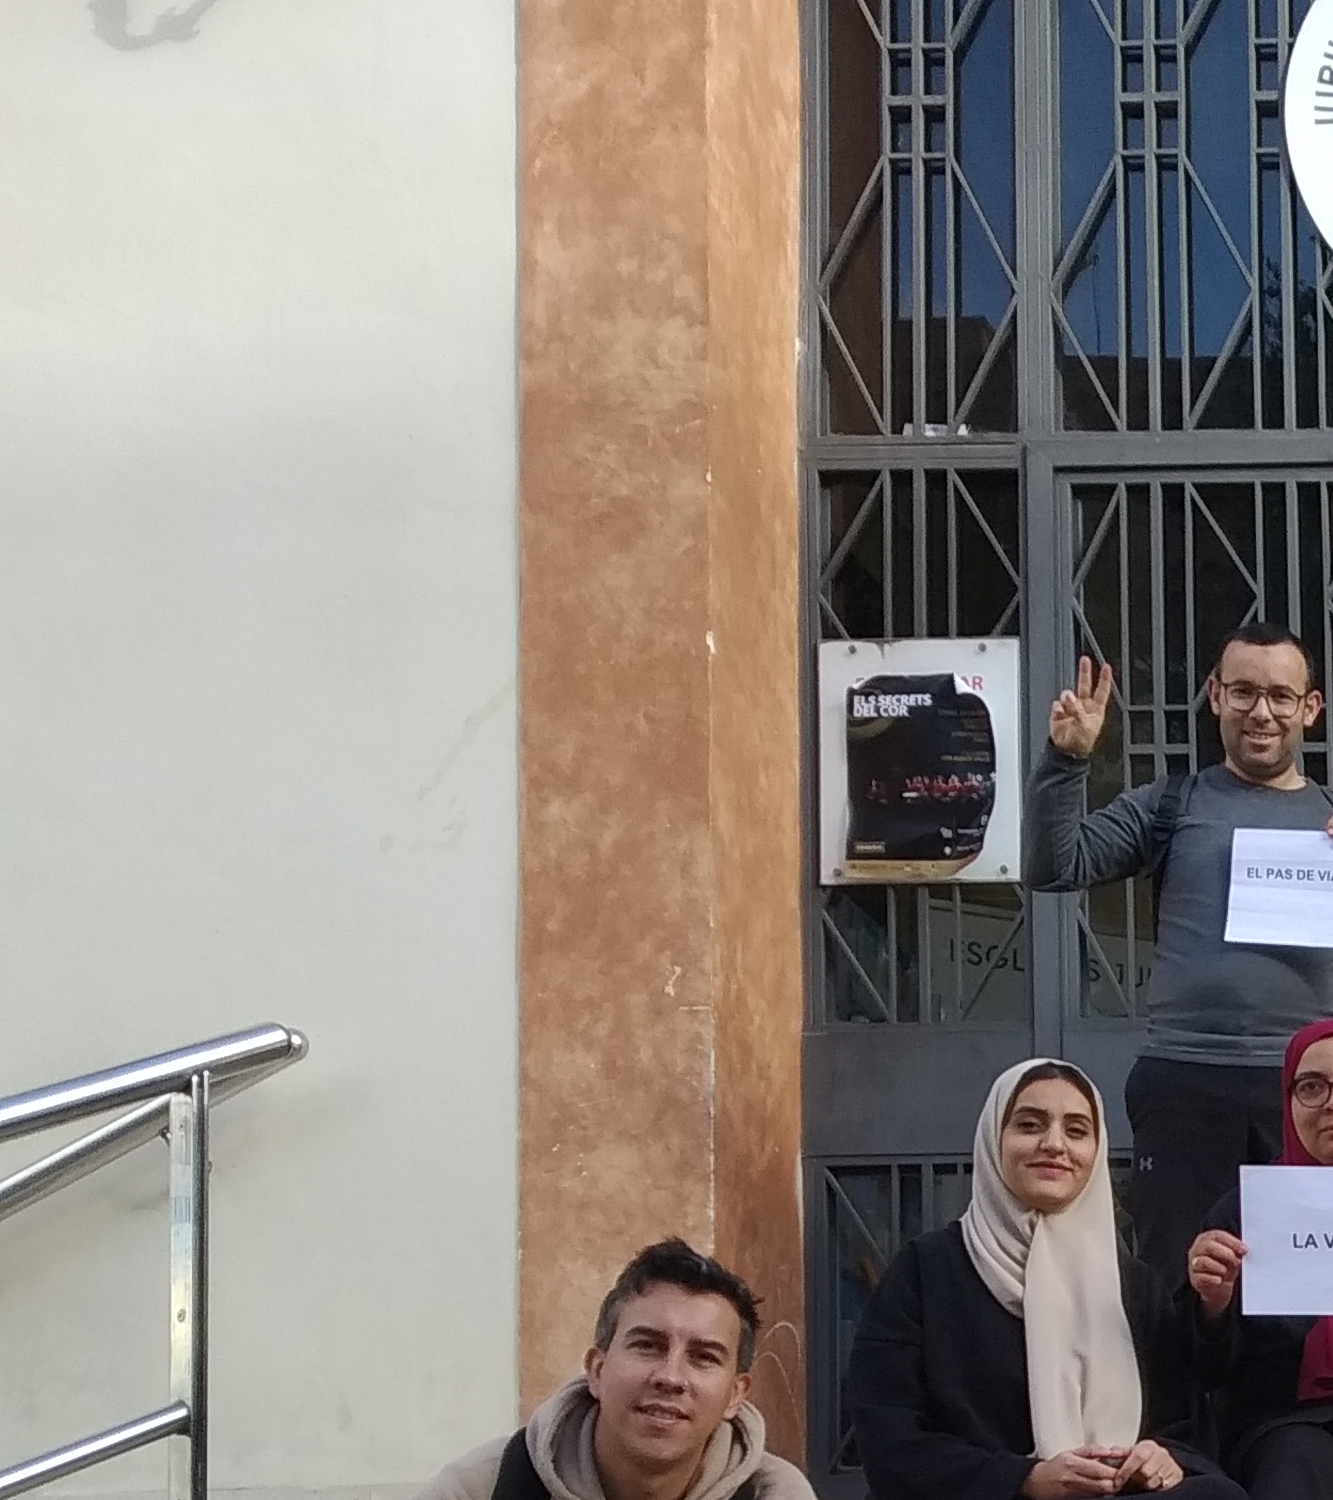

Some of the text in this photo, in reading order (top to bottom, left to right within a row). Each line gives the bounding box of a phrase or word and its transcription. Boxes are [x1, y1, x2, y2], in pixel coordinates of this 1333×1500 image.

[853, 693, 933, 706] ELS SECRETS
[853, 705, 910, 717] DEL COR
[1246, 867, 1264, 880] EL
[1266, 868, 1294, 881] PAS
[1296, 869, 1314, 881] DE
[1293, 1233, 1318, 1249] LA
